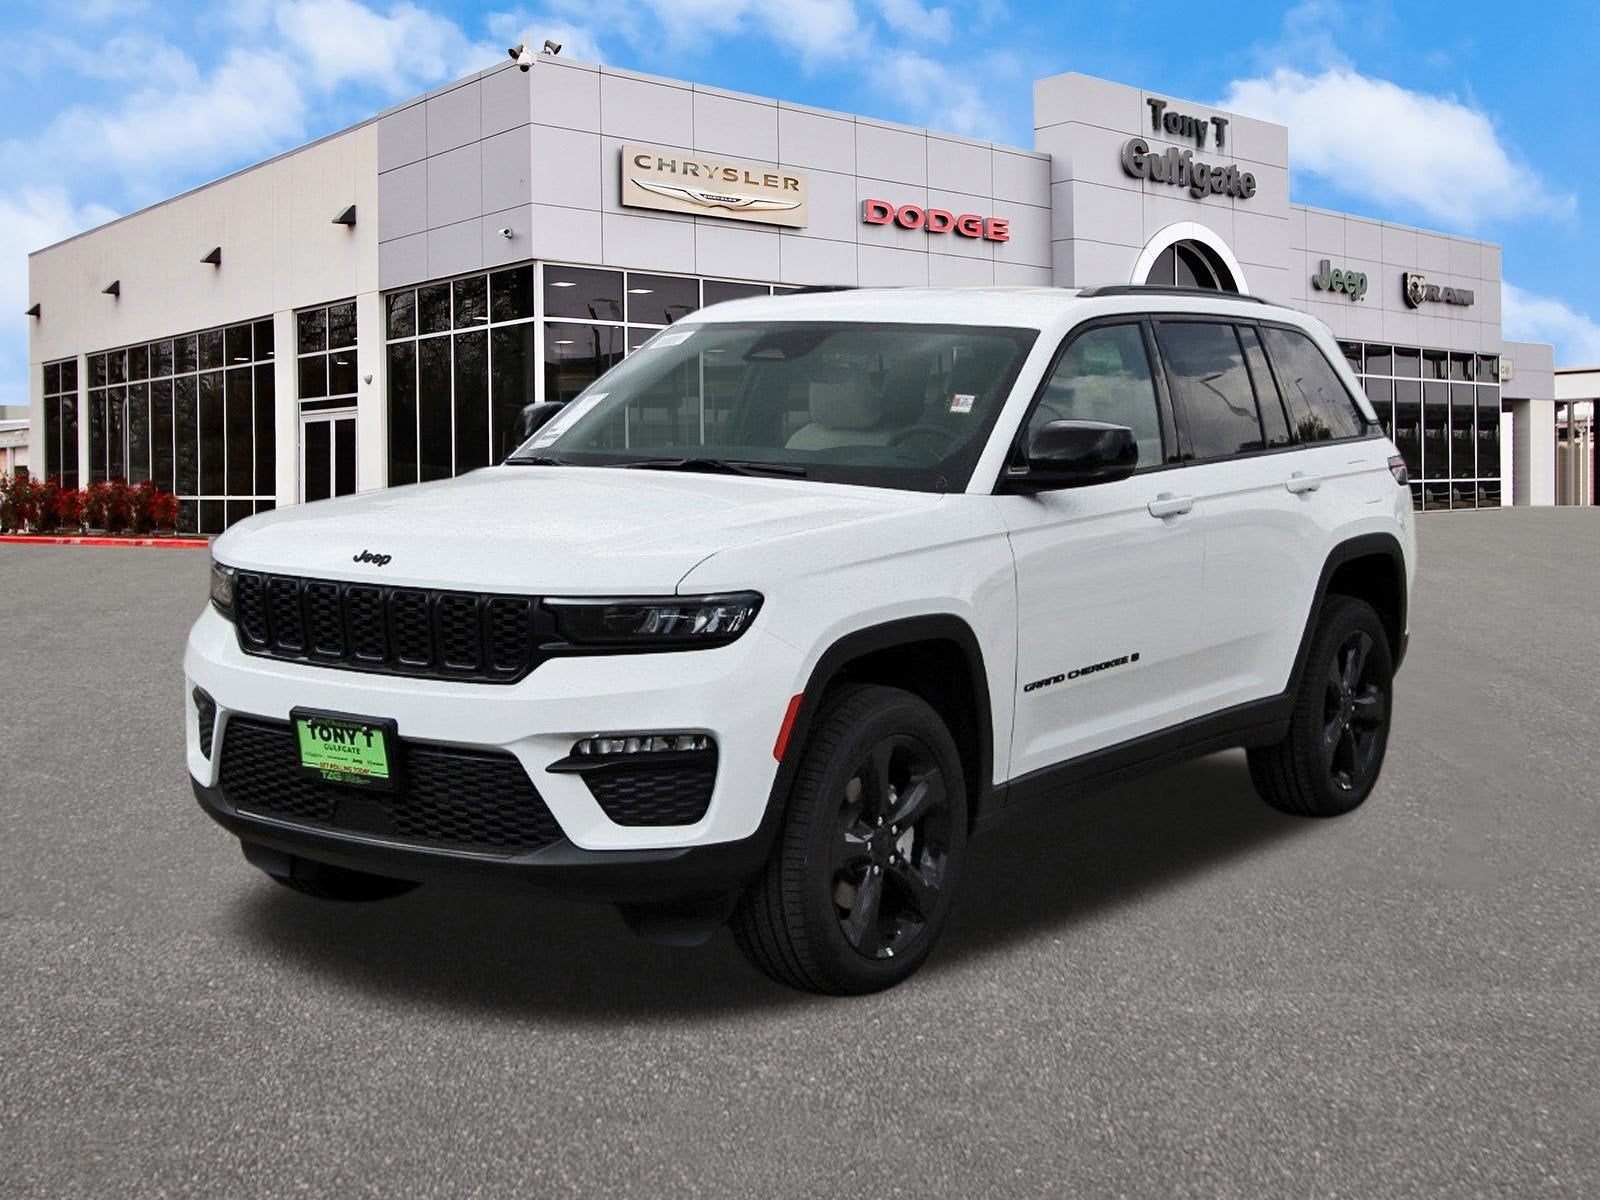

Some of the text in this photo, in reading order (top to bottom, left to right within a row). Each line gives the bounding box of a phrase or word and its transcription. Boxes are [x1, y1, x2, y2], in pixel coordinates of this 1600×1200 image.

[1147, 98, 1229, 148] Tony T
[633, 154, 801, 192] CHRYSLER
[1121, 138, 1257, 199] Gulfgate
[862, 198, 1010, 243] DODGE
[1312, 259, 1368, 302] Jeep
[1424, 283, 1475, 306] RAM
[353, 549, 392, 567] Jeep
[1023, 655, 1129, 693] GRAND CHEROKEE
[306, 722, 357, 746] TONY
[361, 728, 374, 748] T
[323, 743, 361, 755] GULFGATE
